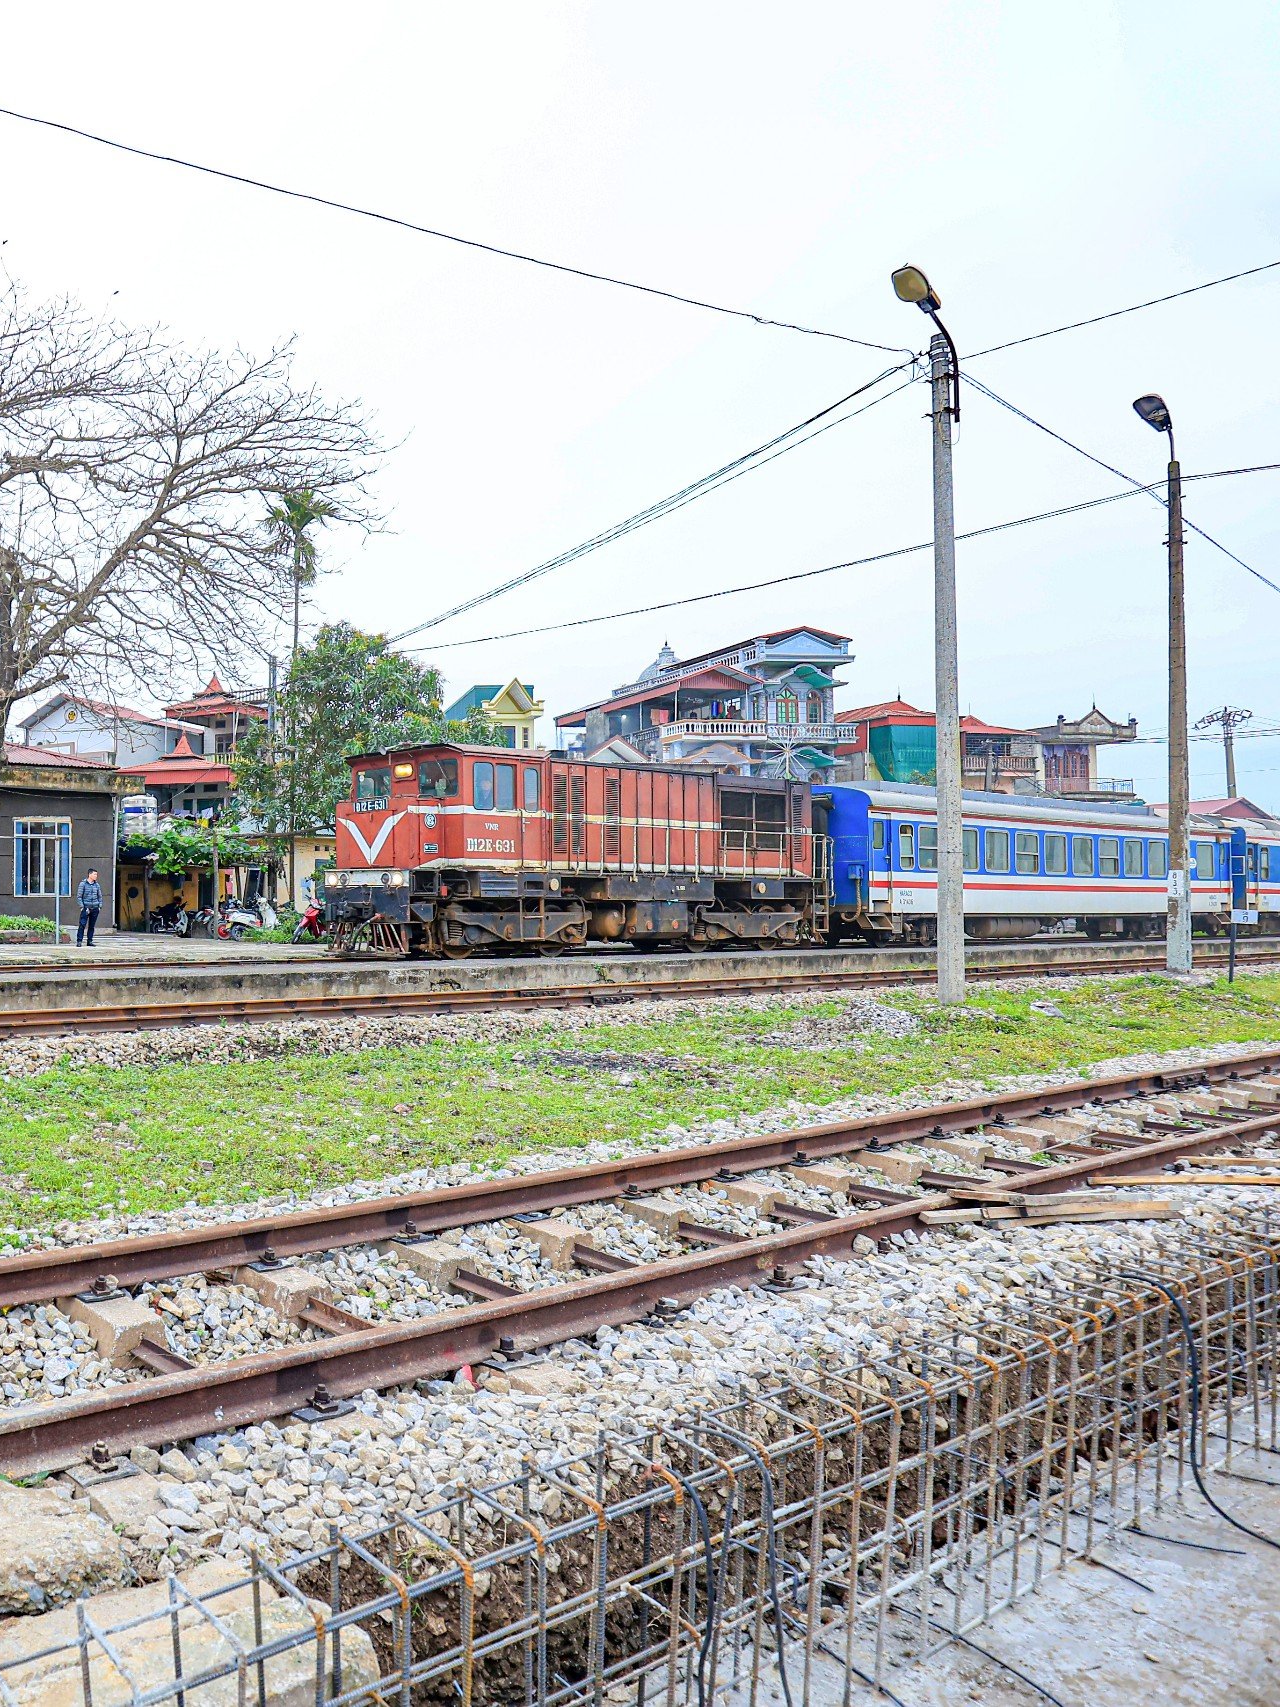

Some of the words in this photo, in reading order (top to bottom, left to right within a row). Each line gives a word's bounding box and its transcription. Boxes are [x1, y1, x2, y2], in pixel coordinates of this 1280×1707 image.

[356, 800, 385, 812] D12E-631
[484, 822, 499, 831] VNR
[466, 837, 516, 853] D12E-631
